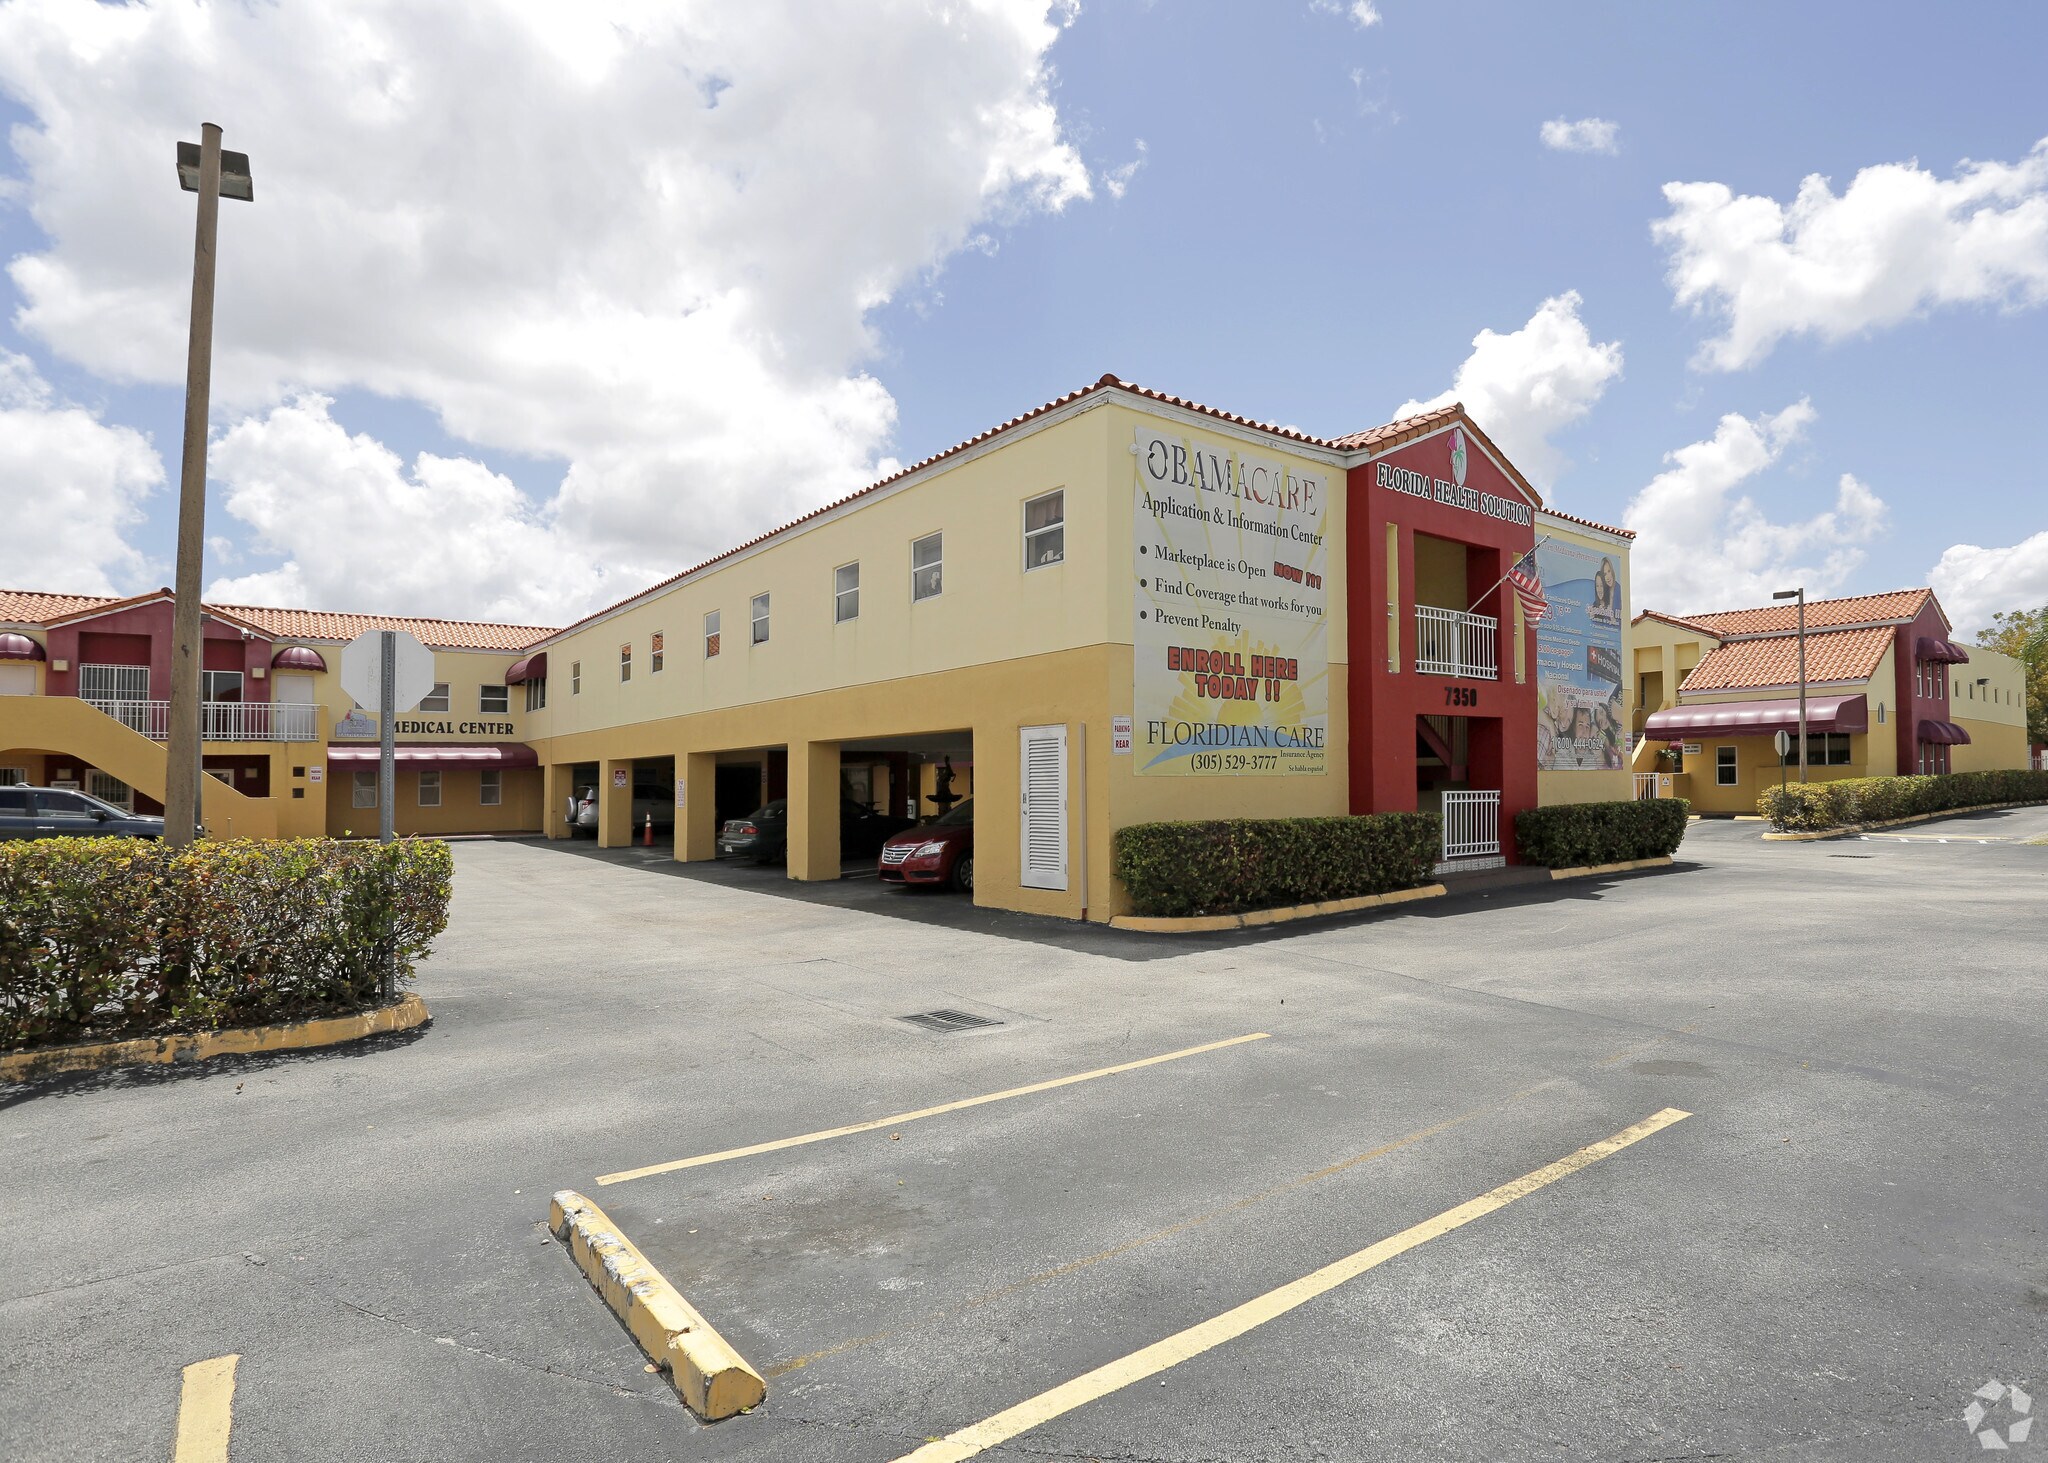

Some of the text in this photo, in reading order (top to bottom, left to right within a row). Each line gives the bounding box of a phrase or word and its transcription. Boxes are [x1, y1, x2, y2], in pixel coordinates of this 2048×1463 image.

[1147, 439, 1318, 516] OBAMACARE
[1377, 462, 1531, 526] FLORIDA HEALTH SOLUTION
[1142, 491, 1323, 546] Application & Information Center
[1154, 545, 1225, 570] Marketplace
[1227, 559, 1236, 572] is
[1238, 560, 1267, 579] Open
[1273, 561, 1304, 585] NOW
[1155, 578, 1322, 618] Find Coverage that works for you
[1155, 608, 1241, 636] Prevent Penalty
[1167, 646, 1298, 681] ENROLL HERE
[1562, 661, 1583, 671] Hospital
[1195, 674, 1281, 702] TODAY !!
[1444, 686, 1477, 707] 7350
[459, 722, 514, 735] CENTER
[1147, 720, 1325, 748] FLORIDIAN CARE
[1115, 740, 1130, 748] REAR
[1280, 750, 1324, 760] Insurance Agency
[1191, 753, 1278, 772] (305) 529-3777
